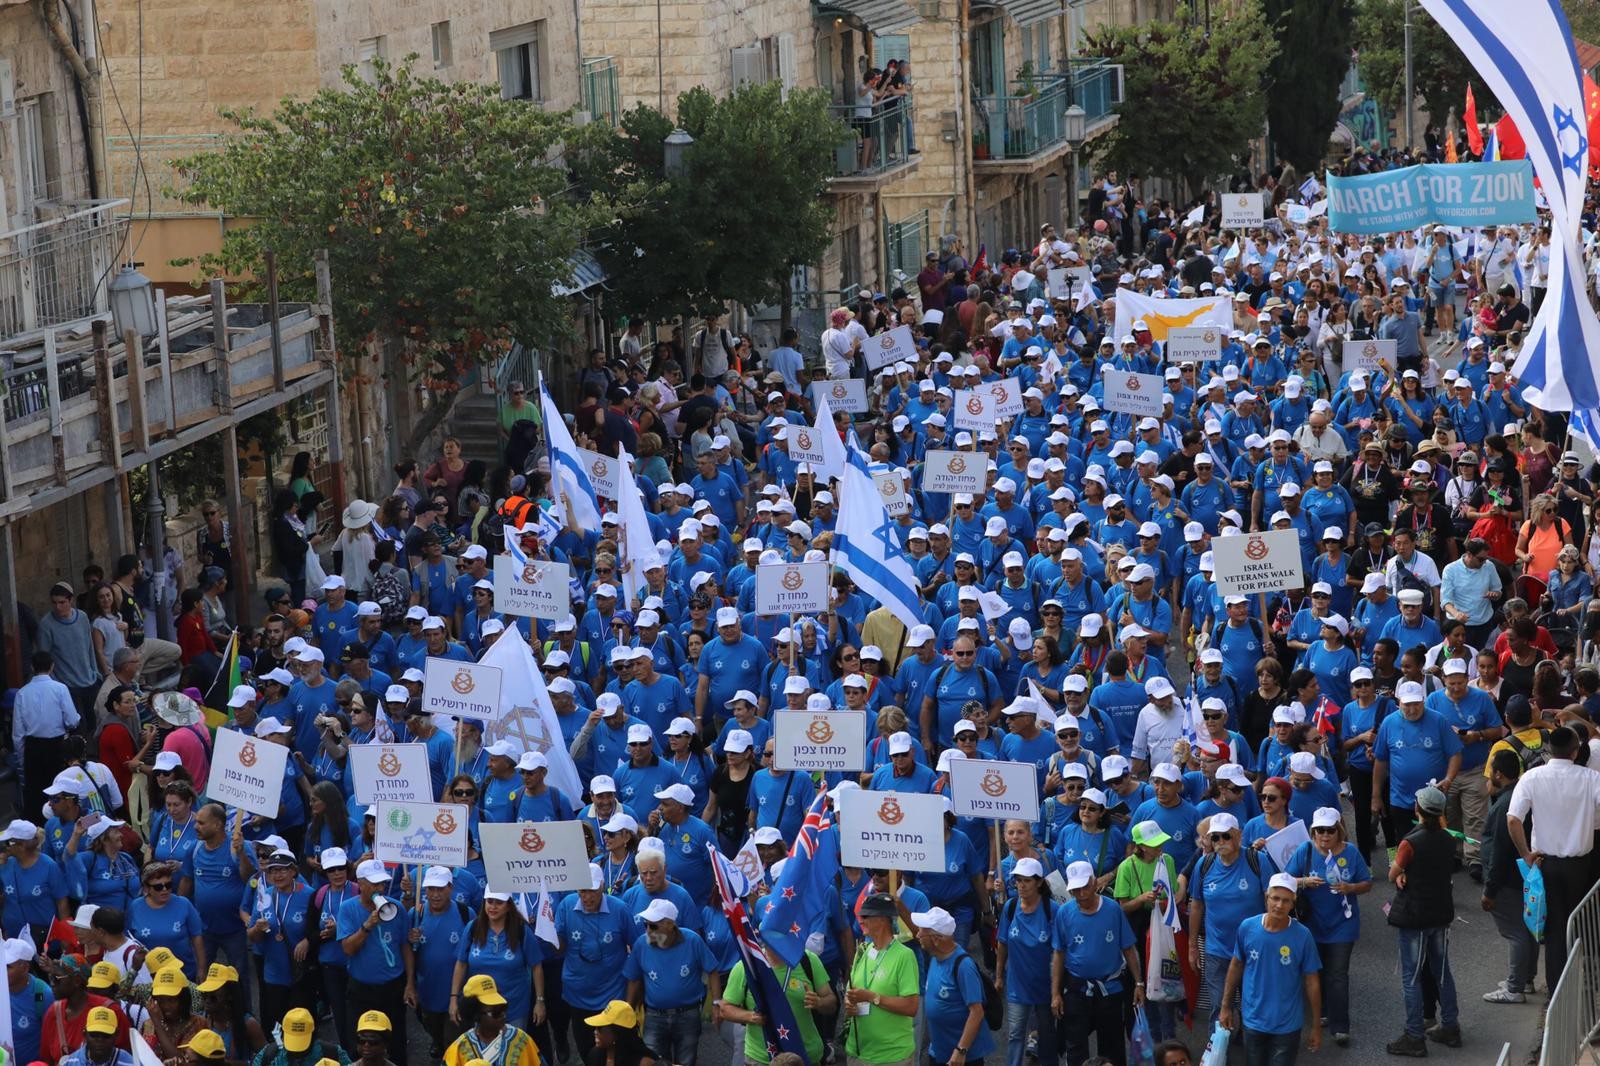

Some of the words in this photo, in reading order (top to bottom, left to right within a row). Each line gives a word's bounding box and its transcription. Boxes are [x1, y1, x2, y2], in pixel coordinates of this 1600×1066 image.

[1328, 180, 1412, 215] MARCH
[1416, 175, 1463, 204] FOR
[1470, 172, 1525, 204] ZION
[1358, 217, 1370, 226] WE
[1370, 215, 1394, 226] STAND
[1395, 211, 1414, 223] WITH
[1415, 207, 1428, 218] YOU
[790, 451, 804, 459] שרון
[806, 454, 822, 462] מחוז
[885, 501, 904, 512] סניף
[1244, 562, 1274, 572] ISRAEL
[1224, 572, 1269, 583] VETERANS
[1270, 569, 1296, 578] WALK
[1238, 582, 1256, 592] FOR
[1258, 580, 1284, 589] PEACE
[510, 587, 528, 596] צפון
[788, 592, 808, 600] מחוז
[777, 593, 786, 602] דן
[504, 599, 522, 608] עליון
[524, 600, 538, 609] גליל
[430, 696, 467, 710] ירושלים
[470, 703, 492, 714] מחוז
[793, 746, 817, 756] צפון
[820, 746, 846, 754] מחוז
[794, 759, 824, 768] כרמיאל
[826, 760, 846, 768] סניף
[224, 768, 242, 782] צפון
[244, 774, 264, 788] מחוז
[376, 780, 385, 790] דן
[390, 780, 409, 788] מחוז
[218, 784, 248, 800] העמקים
[250, 794, 266, 804] סניף
[970, 800, 992, 810] צפון
[996, 802, 1021, 812] מחוז
[861, 832, 890, 842] דרום
[894, 833, 923, 844] מחוז
[861, 848, 900, 860] אופקים
[902, 850, 926, 862] סניף
[505, 860, 533, 872] שרון
[536, 858, 566, 867] מחוז
[512, 876, 541, 884] נתניה
[544, 874, 568, 884] סניף
